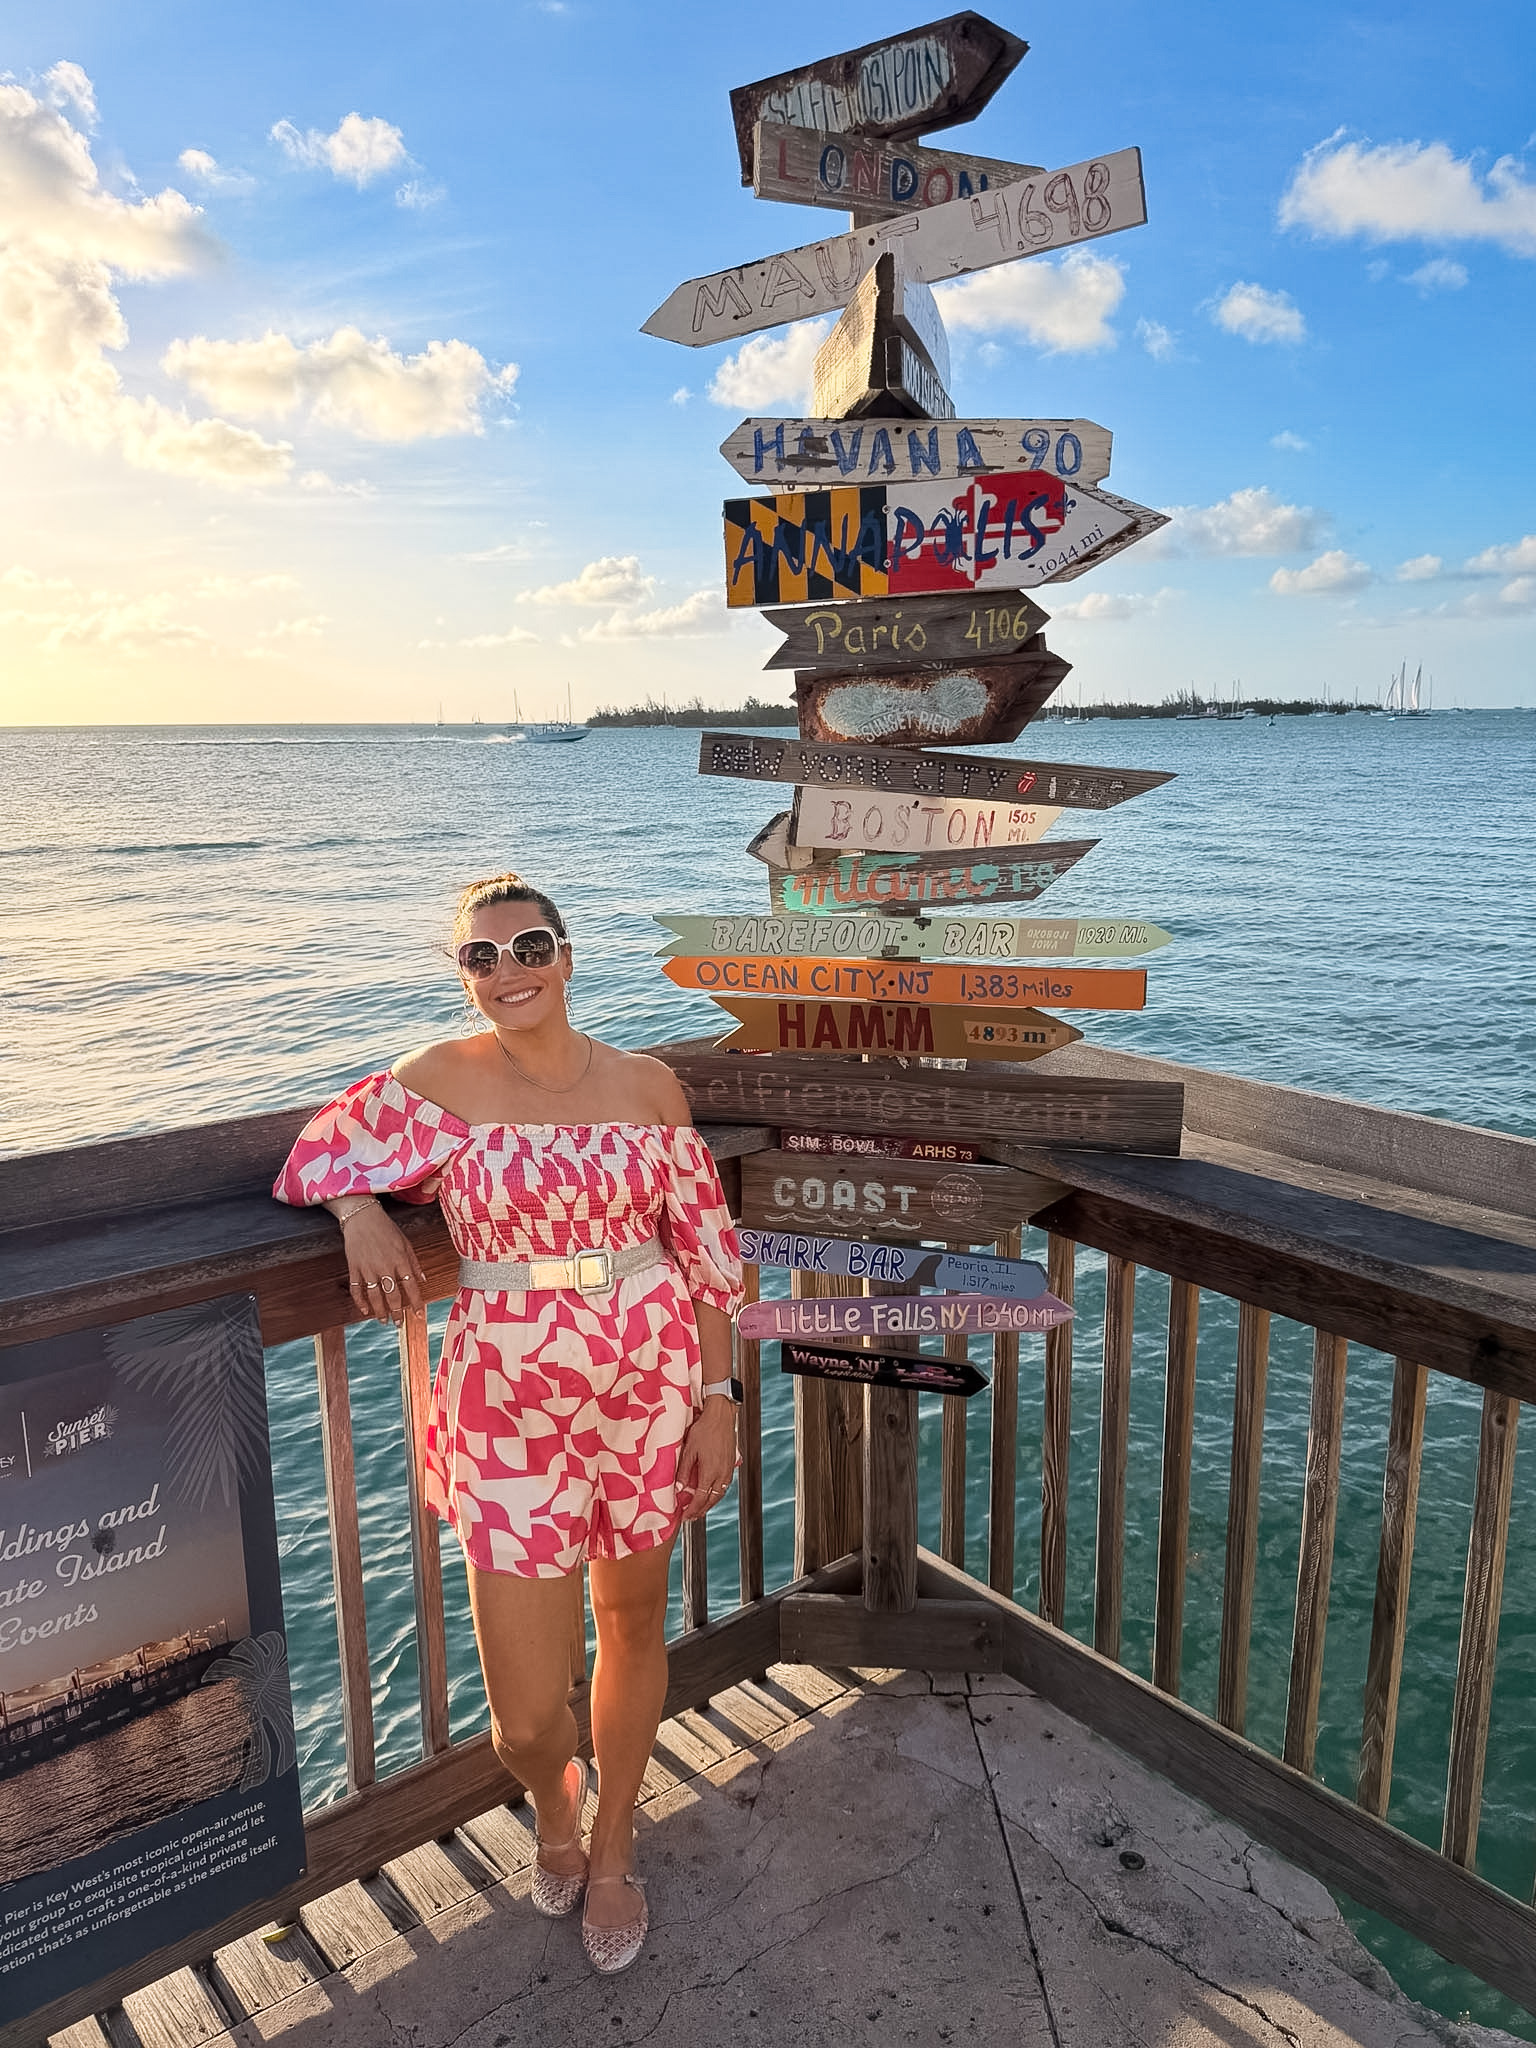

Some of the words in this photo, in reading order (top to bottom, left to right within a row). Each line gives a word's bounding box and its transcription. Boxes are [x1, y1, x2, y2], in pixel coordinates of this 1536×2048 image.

[753, 422, 986, 477] HAVANA
[1022, 428, 1083, 476] 90
[732, 493, 1050, 586] ANNAPOLIS
[1038, 545, 1079, 577] 1044
[1080, 524, 1105, 549] mi
[804, 611, 927, 655] Paris
[861, 709, 915, 741] SUNSET
[712, 743, 785, 776] NEW
[800, 751, 893, 786] YORK
[912, 758, 1010, 796] CITY
[825, 800, 996, 848] BOSTON
[1008, 809, 1037, 825] 1505
[711, 918, 904, 955] BAREFOOT
[942, 922, 1015, 957] BAR
[1032, 939, 1059, 950] IOWA
[1078, 926, 1116, 945] 1920
[1118, 925, 1148, 944] MI.
[696, 961, 798, 990] OCEAN
[899, 971, 933, 996] NJ
[961, 973, 1018, 1001] 1,383
[777, 1003, 935, 1053] HAMM
[969, 1025, 1018, 1042] 4893
[912, 1144, 957, 1159] ARHS
[959, 1150, 973, 1160] 73
[772, 1177, 918, 1215] COAST
[739, 1230, 833, 1272] SHARK
[847, 1242, 907, 1284] BAR
[940, 1303, 971, 1331] NY
[977, 1302, 1030, 1329] 1340
[1032, 1307, 1057, 1327] MI
[858, 1357, 880, 1375] NJ
[48, 1406, 106, 1442] Sunset
[55, 1422, 107, 1456] PIER
[98, 1482, 161, 1531] and
[56, 1524, 168, 1587] Island
[0, 1603, 99, 1651] Events
[4, 1905, 31, 1925] Pier
[32, 1901, 44, 1912] is
[46, 1889, 69, 1906] Key
[71, 1869, 111, 1894] West's
[113, 1855, 143, 1876] most
[145, 1840, 179, 1861] iconic
[181, 1817, 229, 1844] open-air
[231, 1801, 267, 1821] venue.
[28, 1907, 66, 1932] group
[68, 1899, 82, 1911] to
[84, 1873, 138, 1904] exquisite
[140, 1850, 184, 1878] tropical
[186, 1833, 226, 1857] cuisine
[227, 1821, 249, 1839] and
[250, 1814, 265, 1828] let
[51, 1914, 84, 1934] team
[86, 1898, 116, 1918] craft
[117, 1895, 125, 1904] a
[127, 1854, 207, 1899] one-of-a-kind
[209, 1838, 248, 1863] private
[38, 1933, 73, 1957] that's
[75, 1926, 89, 1939] as
[91, 1887, 172, 1931] unforgettable
[173, 1880, 186, 1893] as
[188, 1870, 208, 1886] the
[209, 1852, 248, 1876] setting
[249, 1835, 279, 1857] itself.
